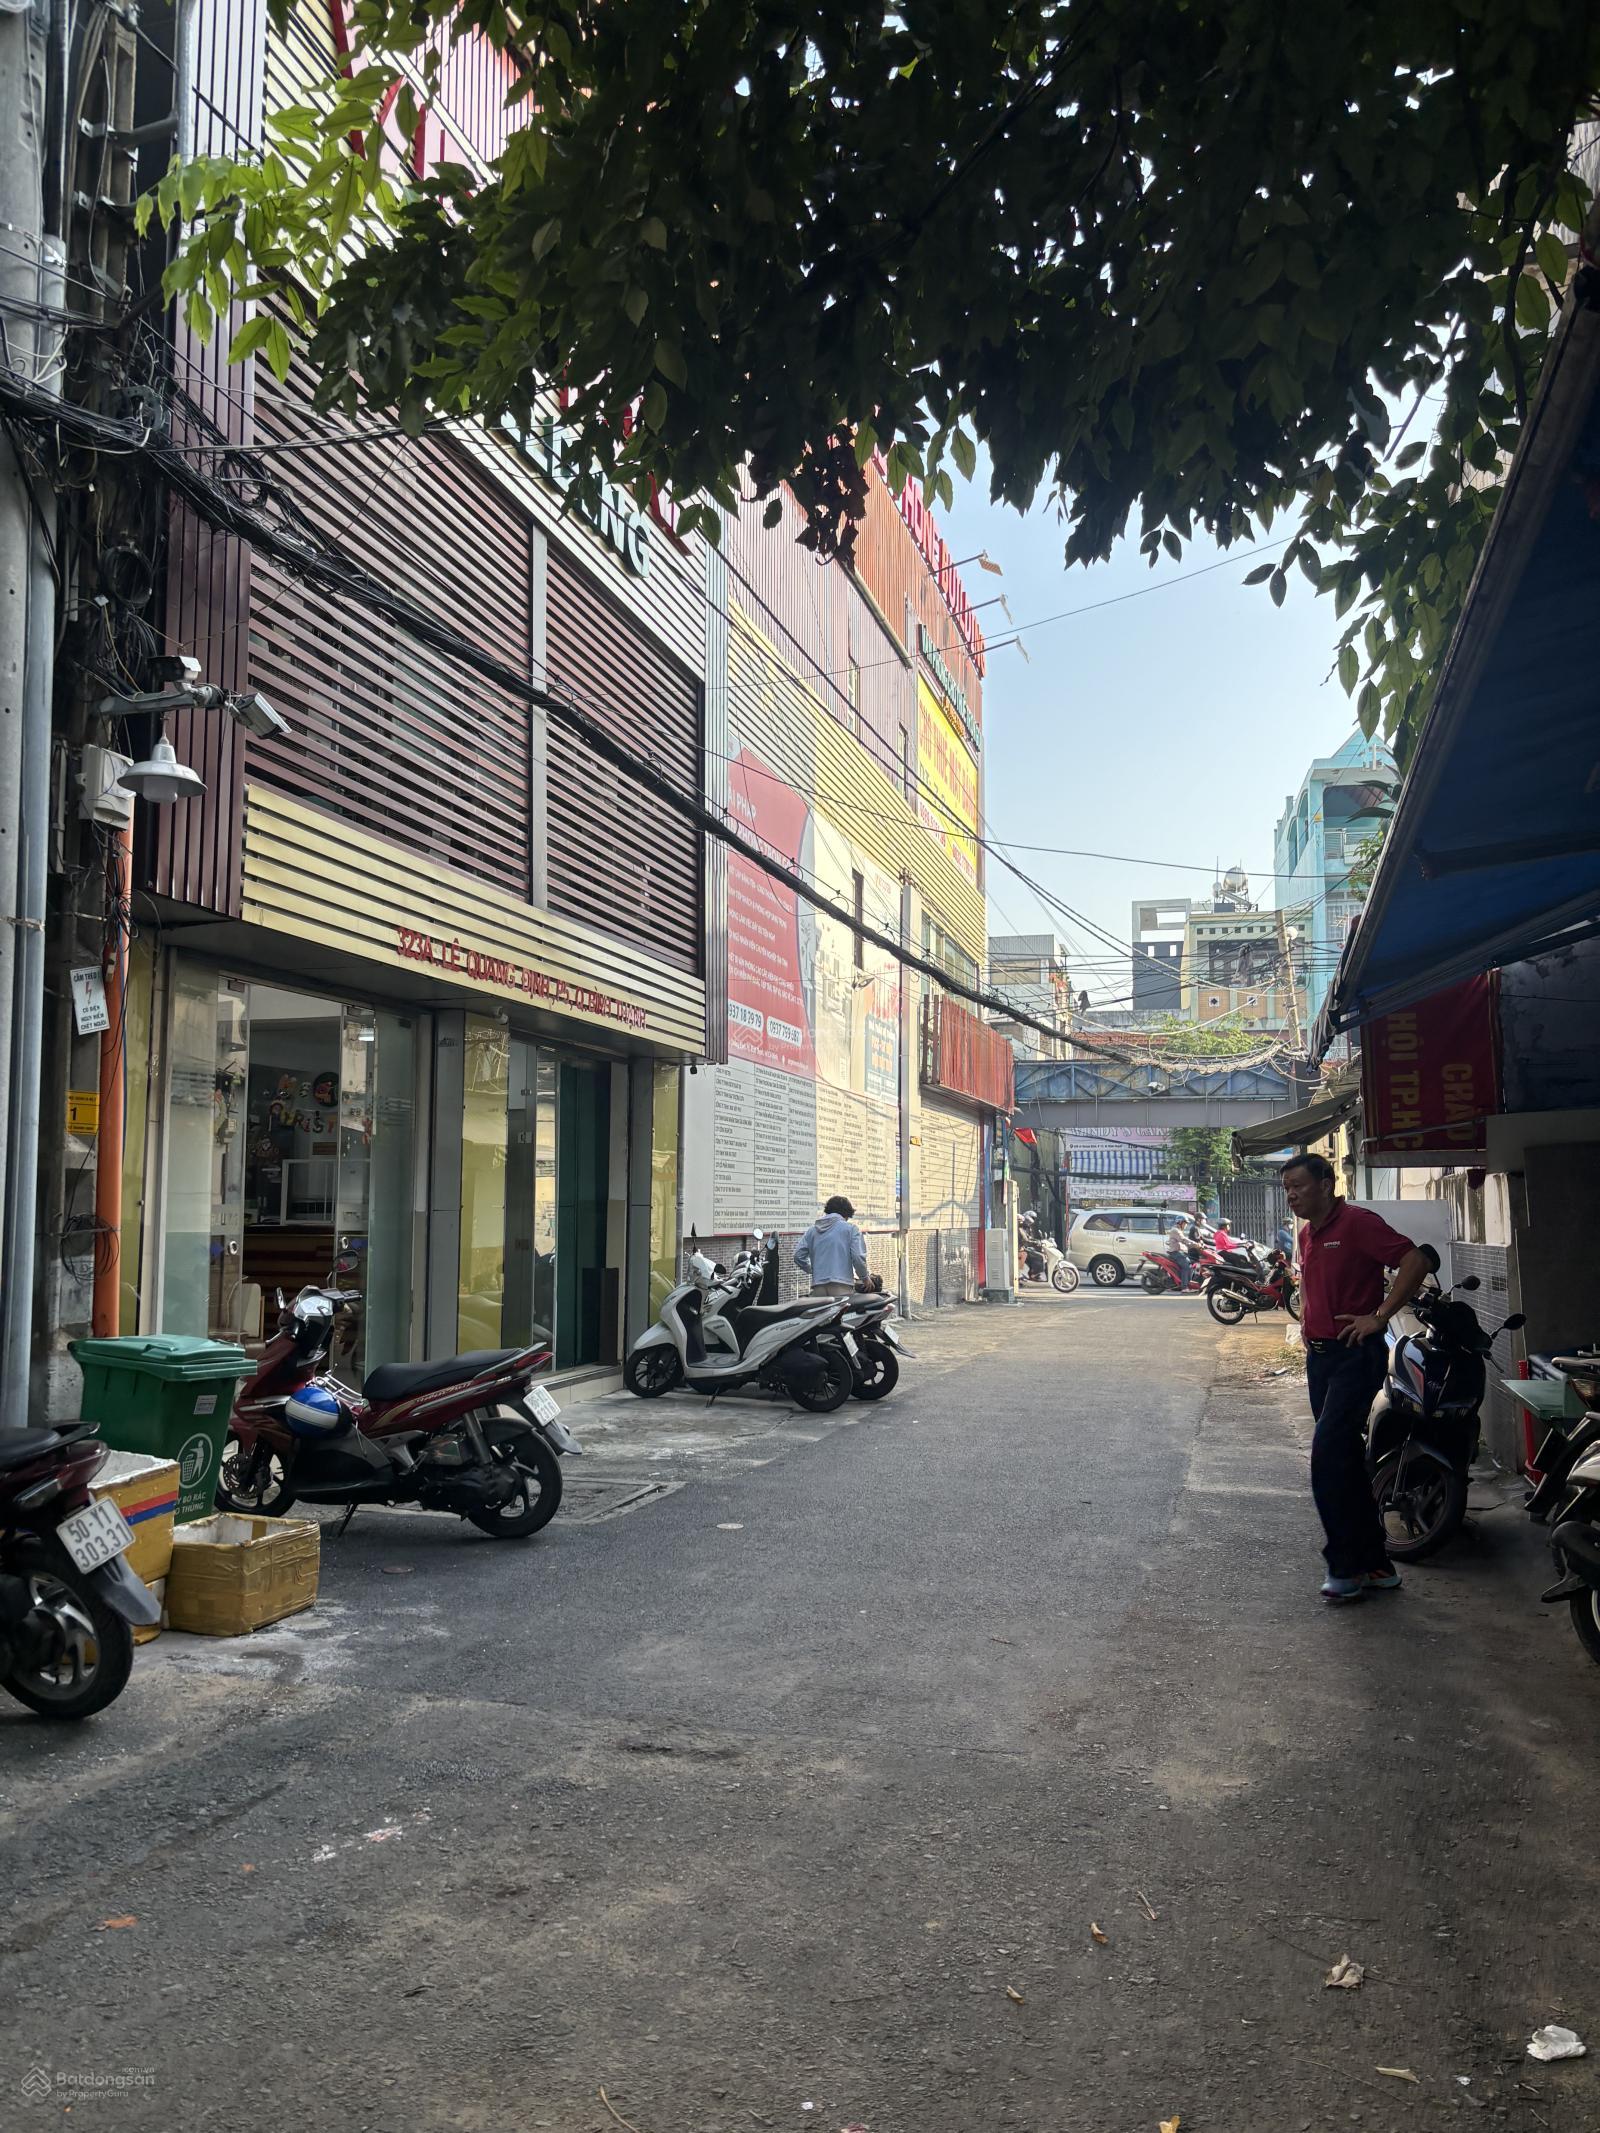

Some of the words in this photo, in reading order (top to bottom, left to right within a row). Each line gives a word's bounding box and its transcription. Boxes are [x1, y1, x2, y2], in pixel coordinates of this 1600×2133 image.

[441, 937, 461, 972] LÊ
[466, 949, 516, 989] QUANG
[68, 1506, 112, 1543] 50-Y1
[75, 1523, 130, 1568] 303.31
